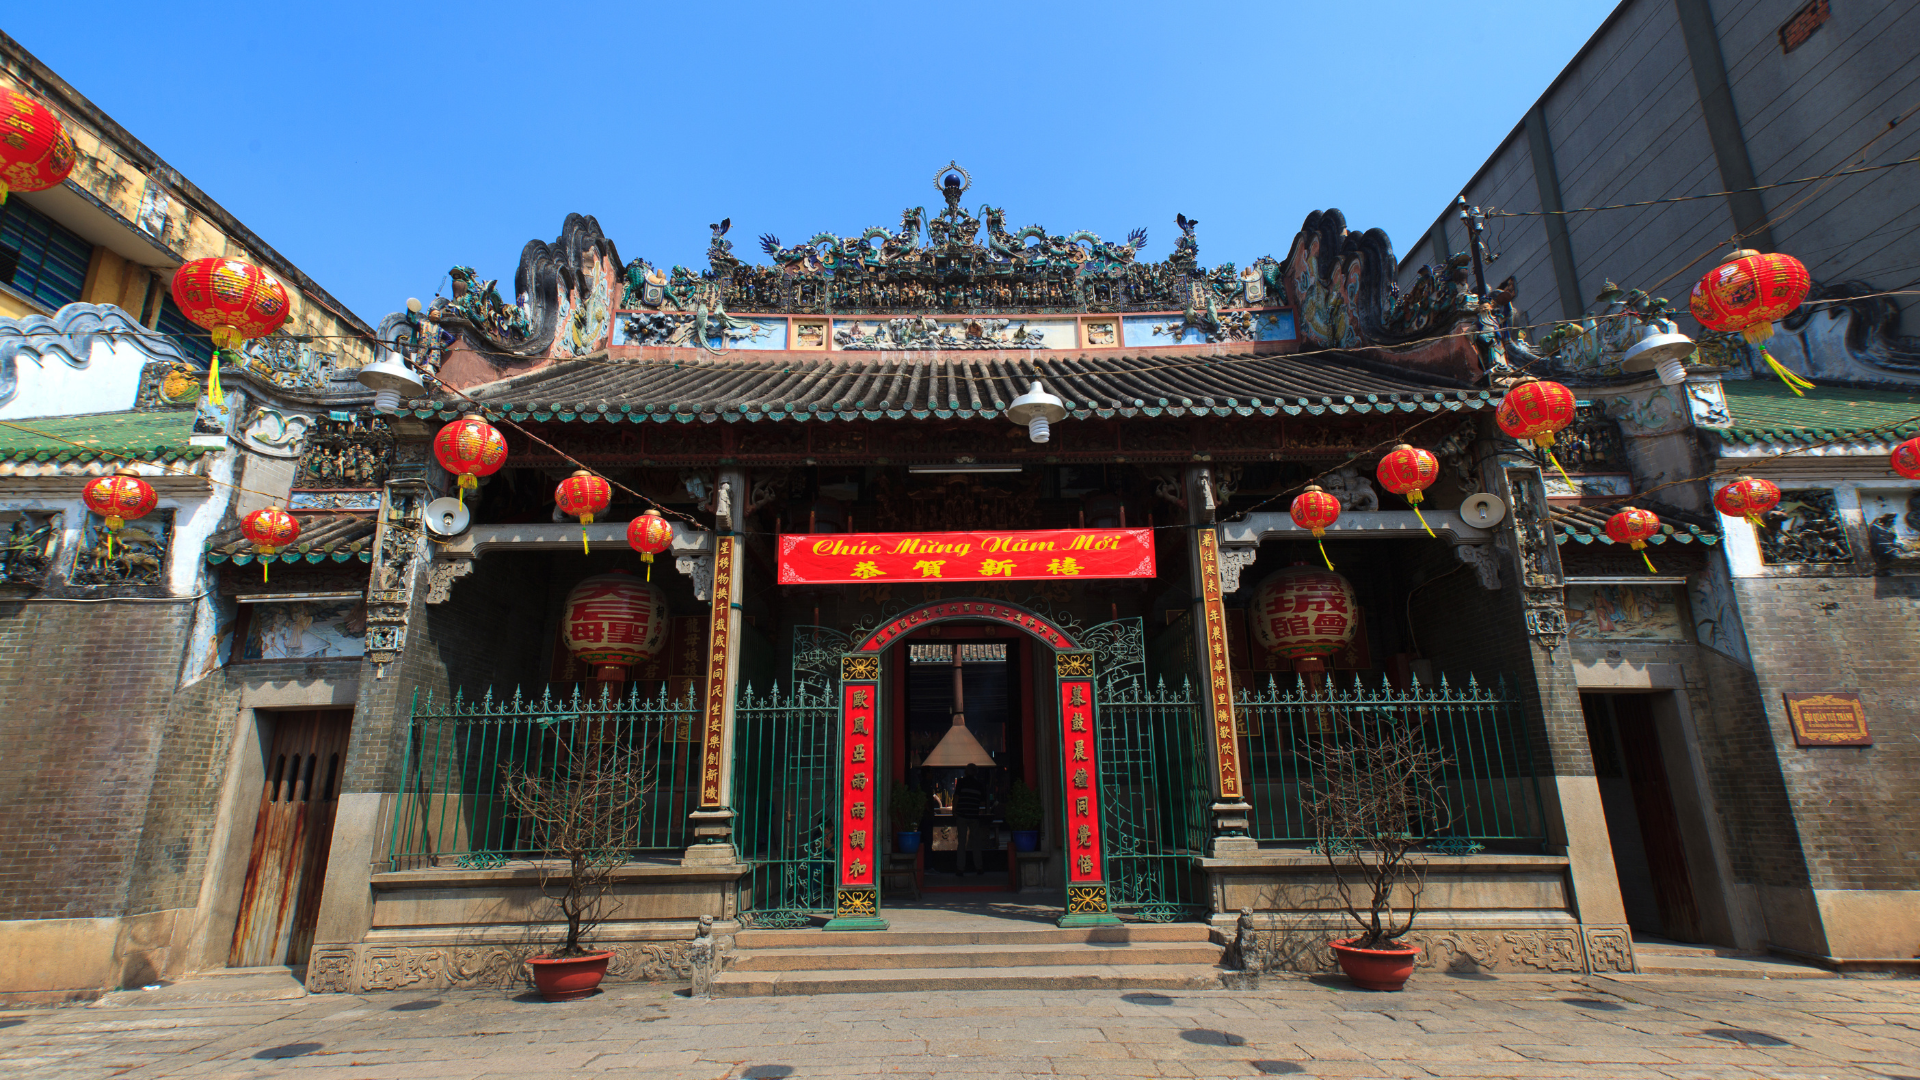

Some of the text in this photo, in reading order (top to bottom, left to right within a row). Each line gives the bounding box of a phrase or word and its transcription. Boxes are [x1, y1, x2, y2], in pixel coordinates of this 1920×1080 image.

[812, 534, 1122, 557] Chúc Mừng Năm Mới
[849, 557, 1086, 580] 恭賀新禧
